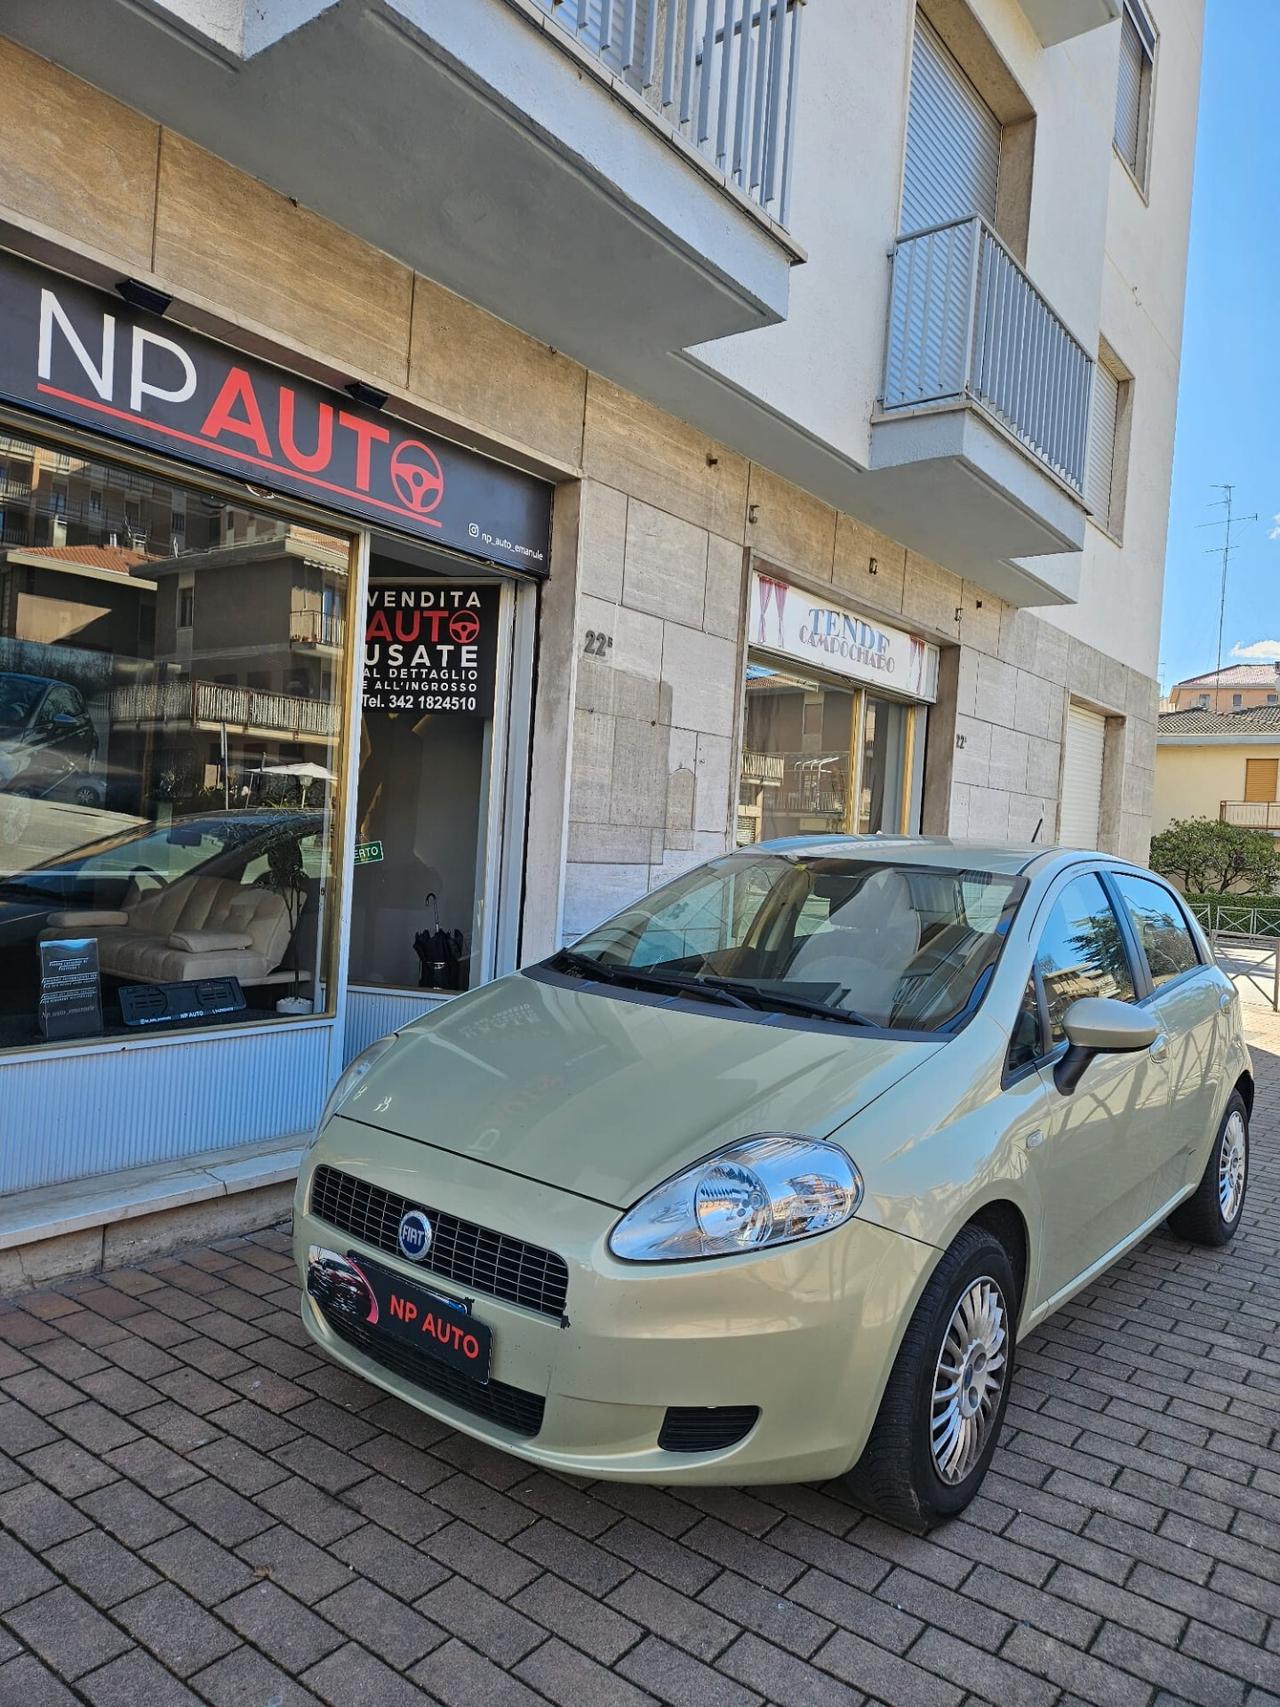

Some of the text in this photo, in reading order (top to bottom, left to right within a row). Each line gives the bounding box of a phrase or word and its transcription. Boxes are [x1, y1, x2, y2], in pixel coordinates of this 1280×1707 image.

[38, 288, 198, 412] NP
[367, 591, 481, 608] VENDITA
[364, 644, 478, 668] USATE
[363, 668, 478, 680] AL DETTAGLIO
[374, 681, 477, 692] ALL'INGROSSO
[362, 694, 476, 711] Tel. 342 1824510
[402, 1224, 425, 1247] FIAT
[389, 1294, 479, 1359] NP AUTO
